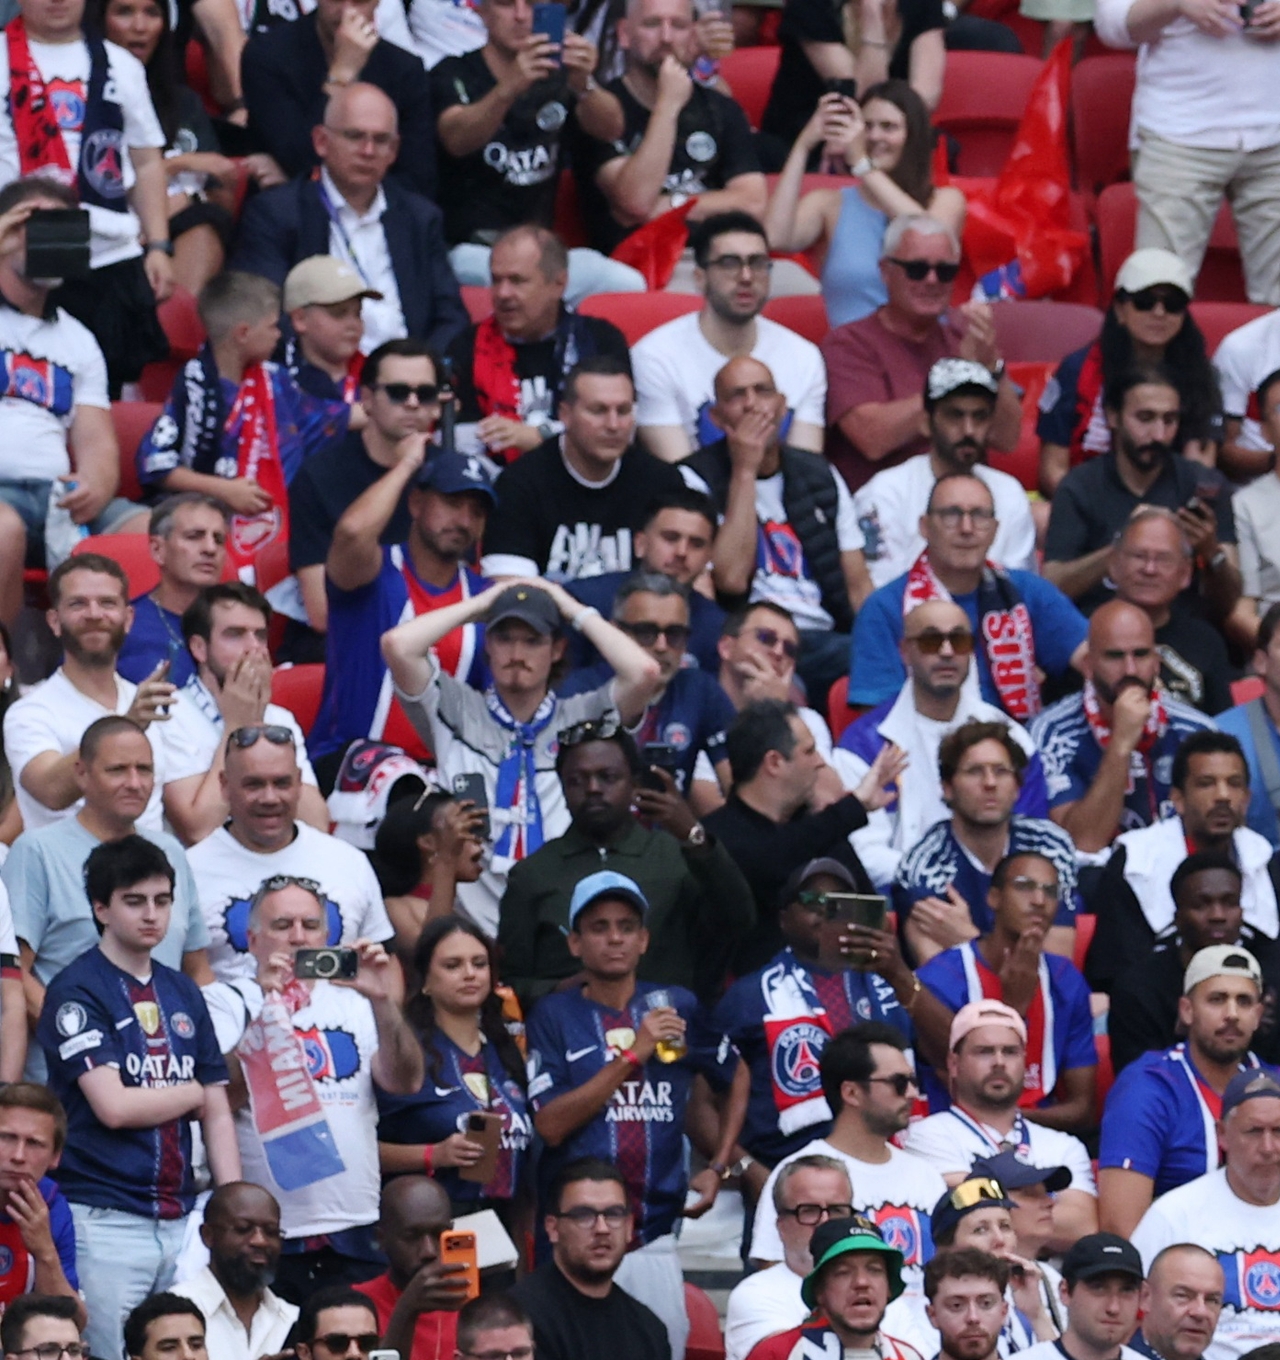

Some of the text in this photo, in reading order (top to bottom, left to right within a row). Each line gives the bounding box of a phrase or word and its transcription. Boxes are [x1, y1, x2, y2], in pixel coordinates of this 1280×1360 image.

[983, 610, 1032, 718] ARIS
[126, 1053, 195, 1082] QATAR
[611, 1080, 673, 1107] ATAR
[605, 1104, 674, 1123] AIRWAYS
